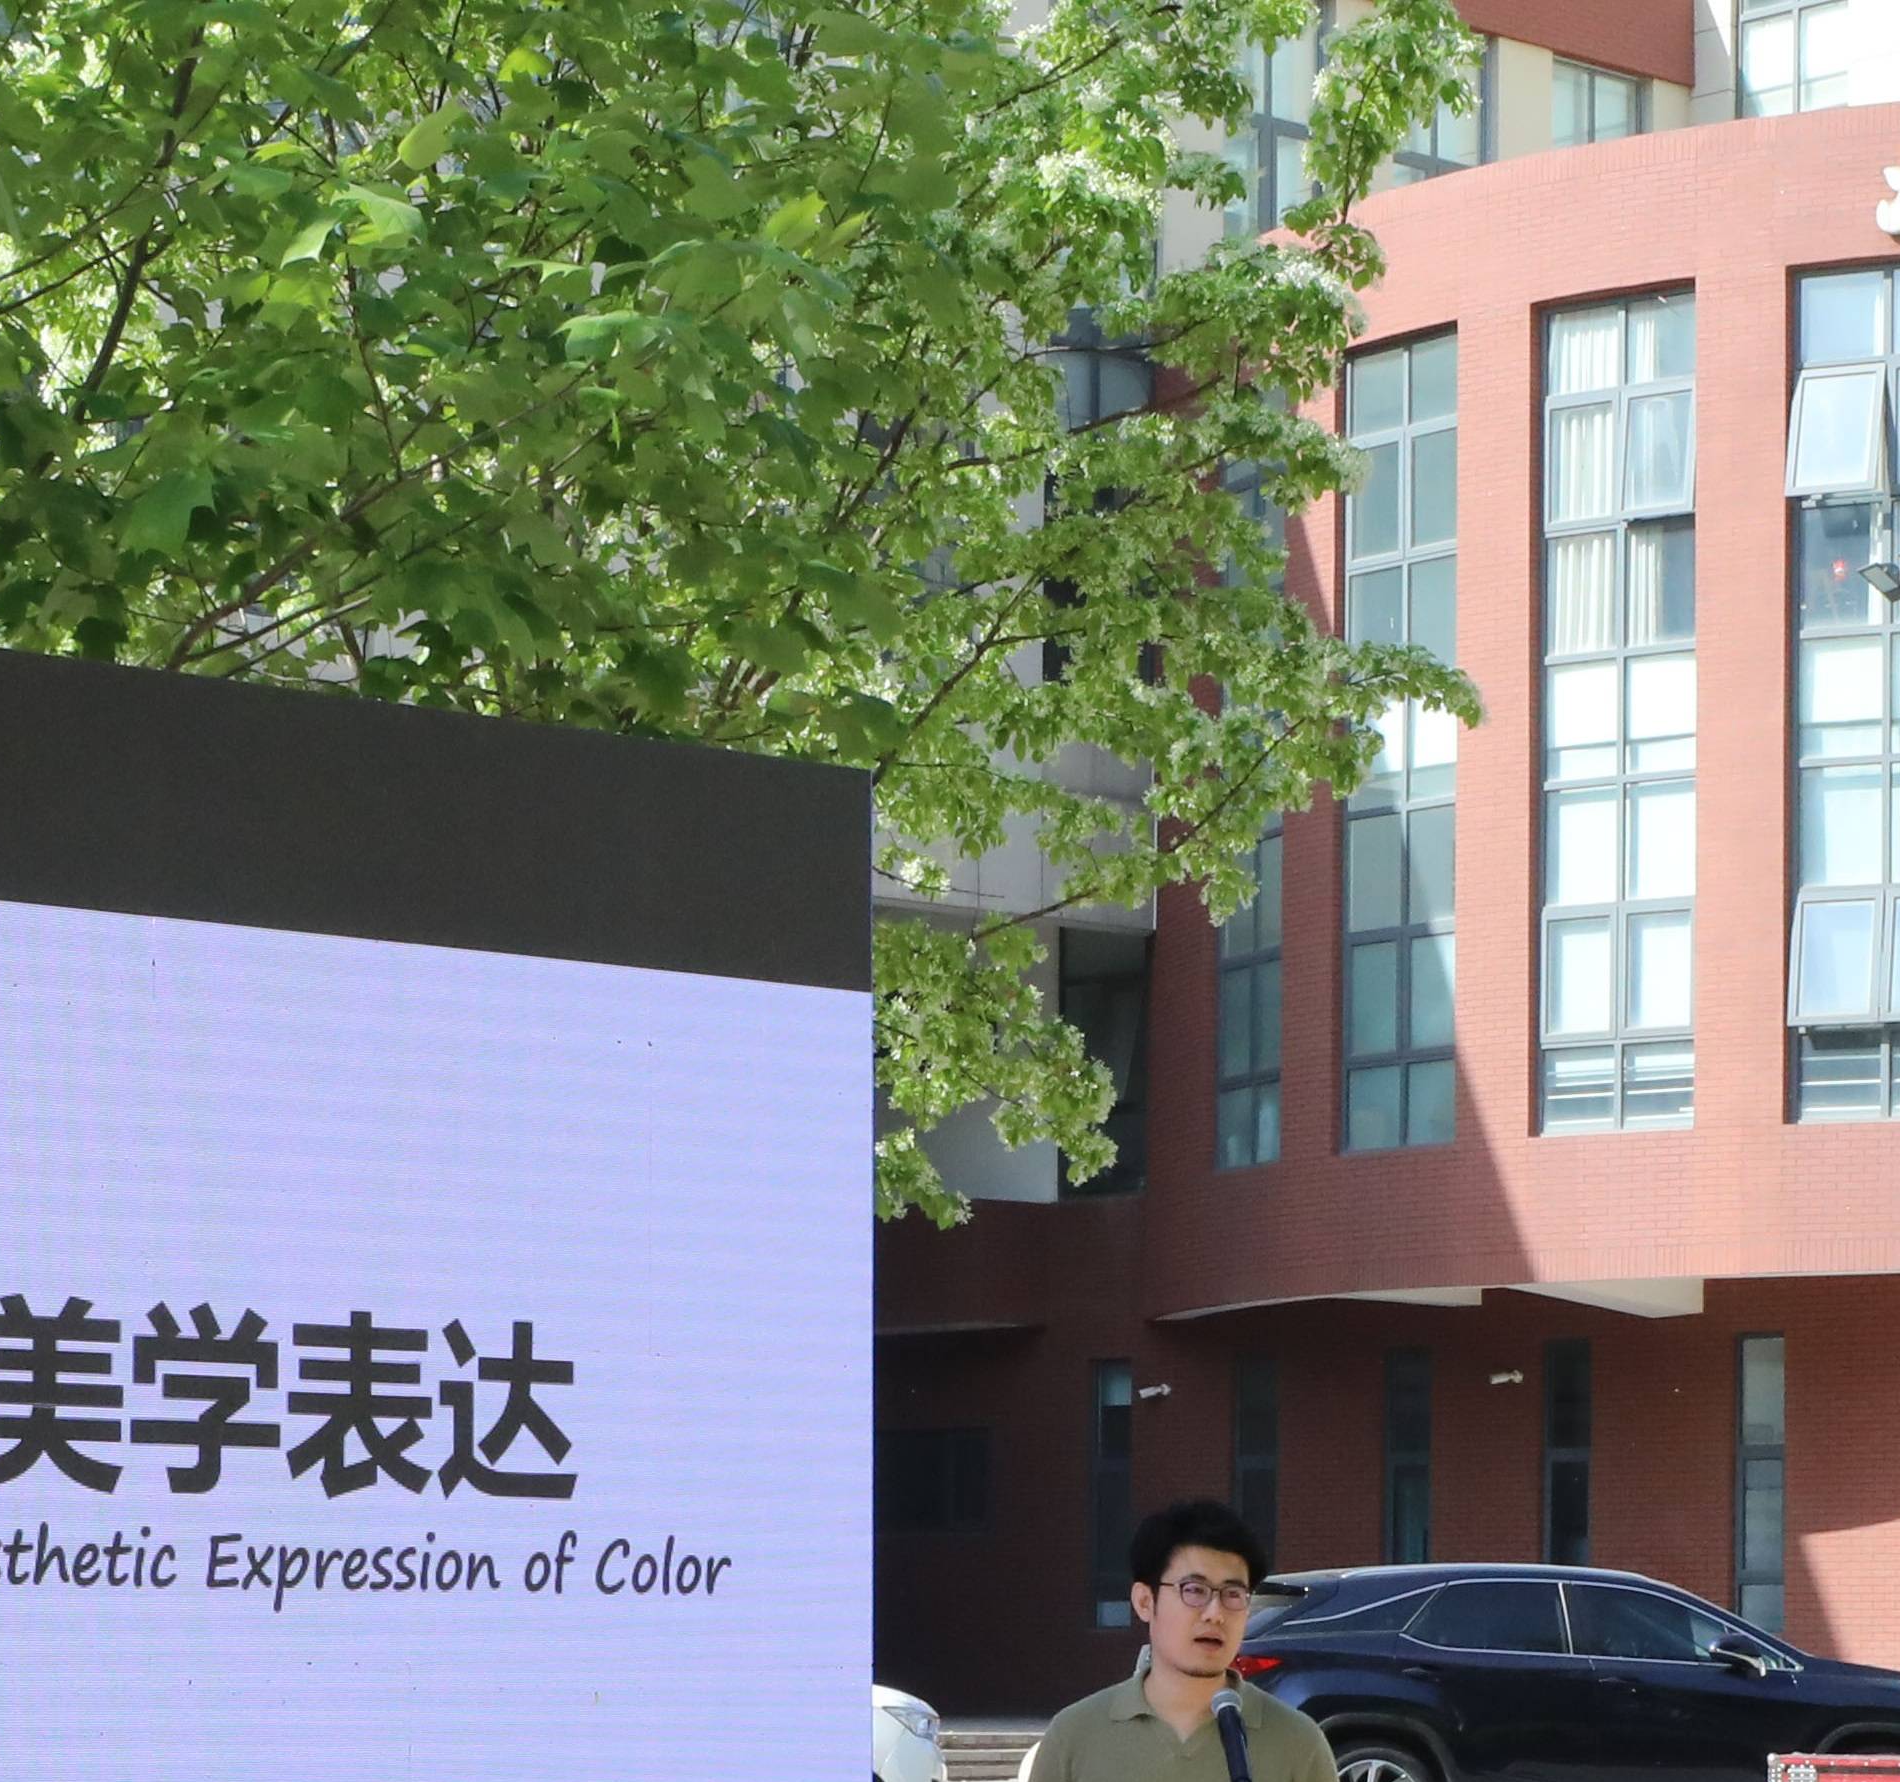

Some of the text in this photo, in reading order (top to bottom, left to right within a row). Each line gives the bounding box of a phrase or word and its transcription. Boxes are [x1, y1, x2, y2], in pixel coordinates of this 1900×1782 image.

[204, 1531, 502, 1612] Expression
[522, 1530, 579, 1594] of
[594, 1534, 733, 1595] Color
